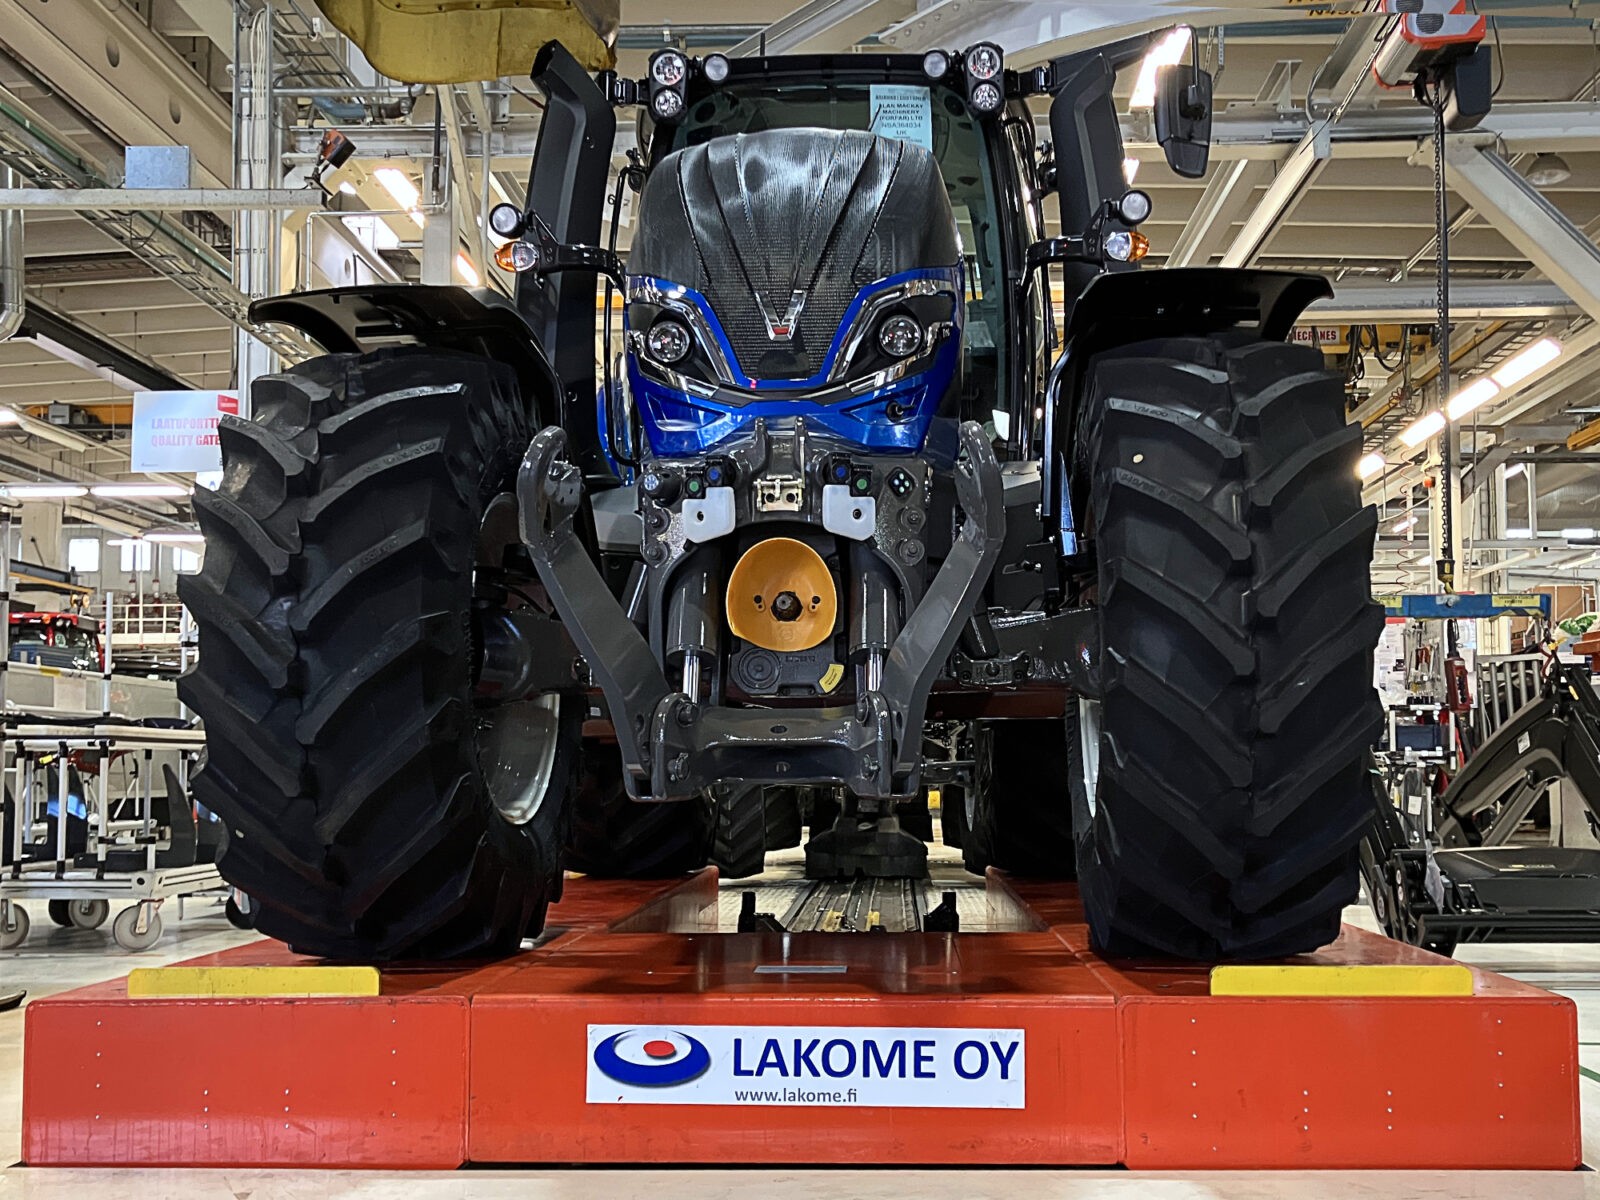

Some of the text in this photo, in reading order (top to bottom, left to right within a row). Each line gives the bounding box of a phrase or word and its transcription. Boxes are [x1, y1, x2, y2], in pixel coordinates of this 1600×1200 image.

[151, 434, 221, 447] QUALITY GATE
[734, 1038, 1020, 1080] LAKOME OY
[735, 1087, 857, 1103] www.lakome.fi
